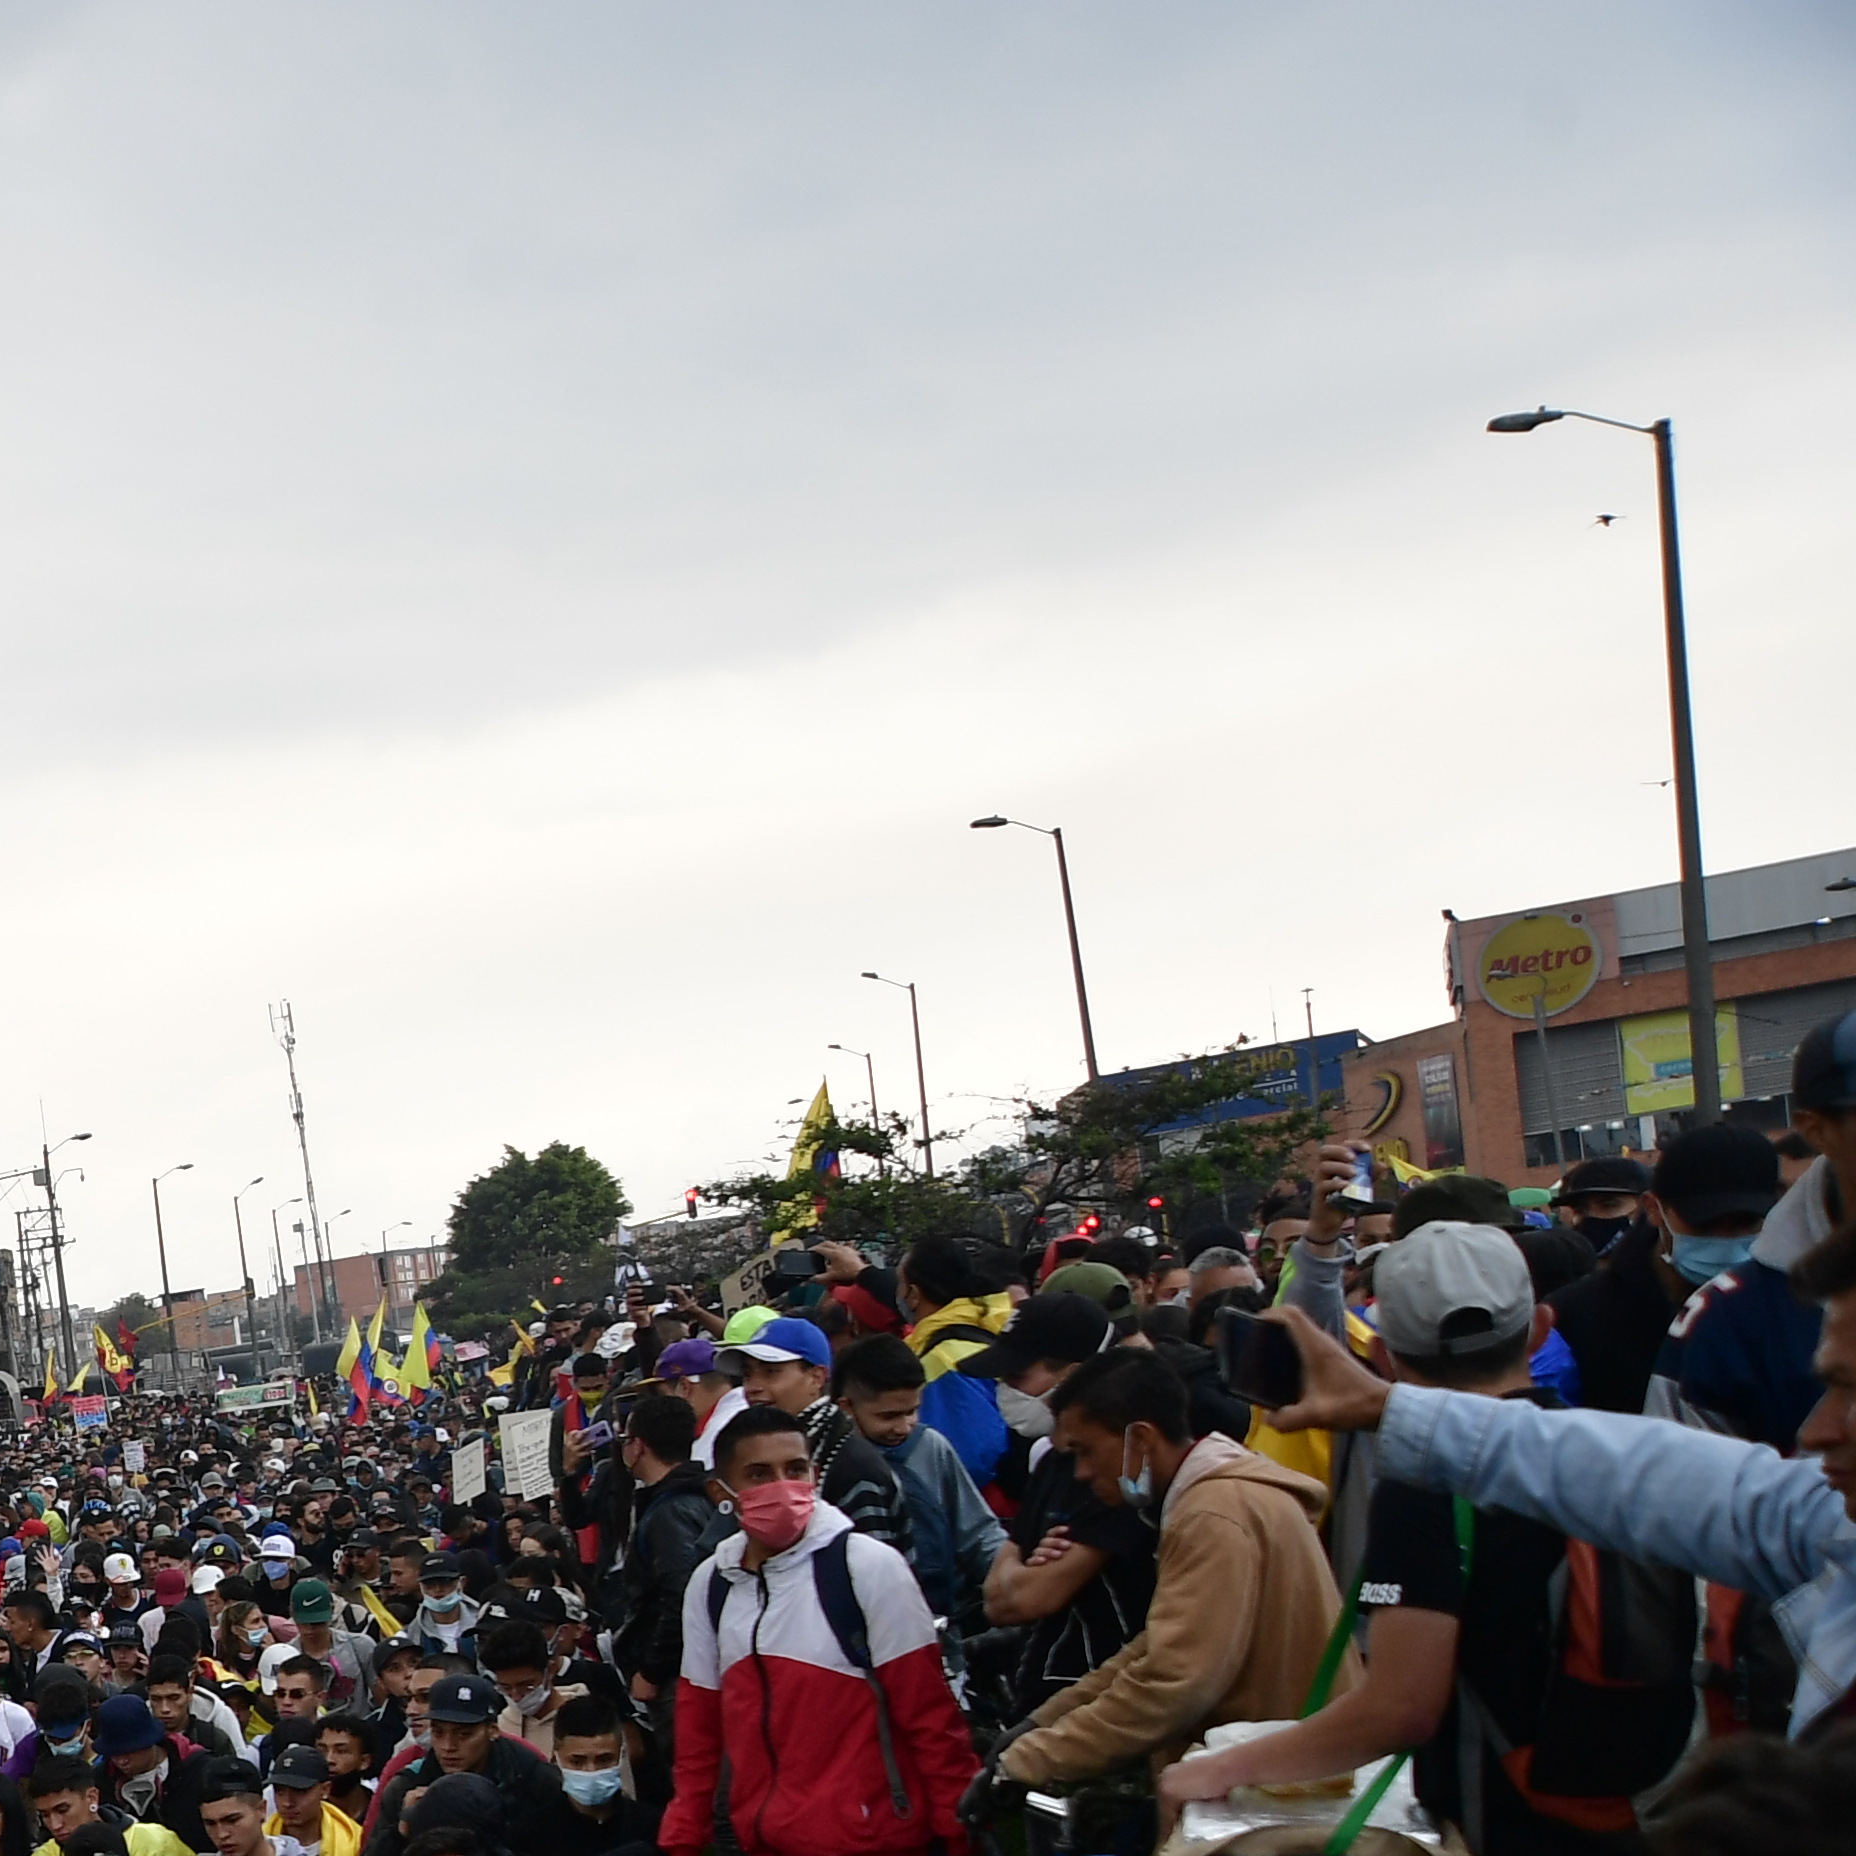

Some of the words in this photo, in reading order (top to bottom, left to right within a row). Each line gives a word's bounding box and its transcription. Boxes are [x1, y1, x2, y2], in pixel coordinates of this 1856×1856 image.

[1486, 945, 1593, 983] Metro
[526, 1588, 542, 1602] H
[1358, 1581, 1402, 1605] BOSS
